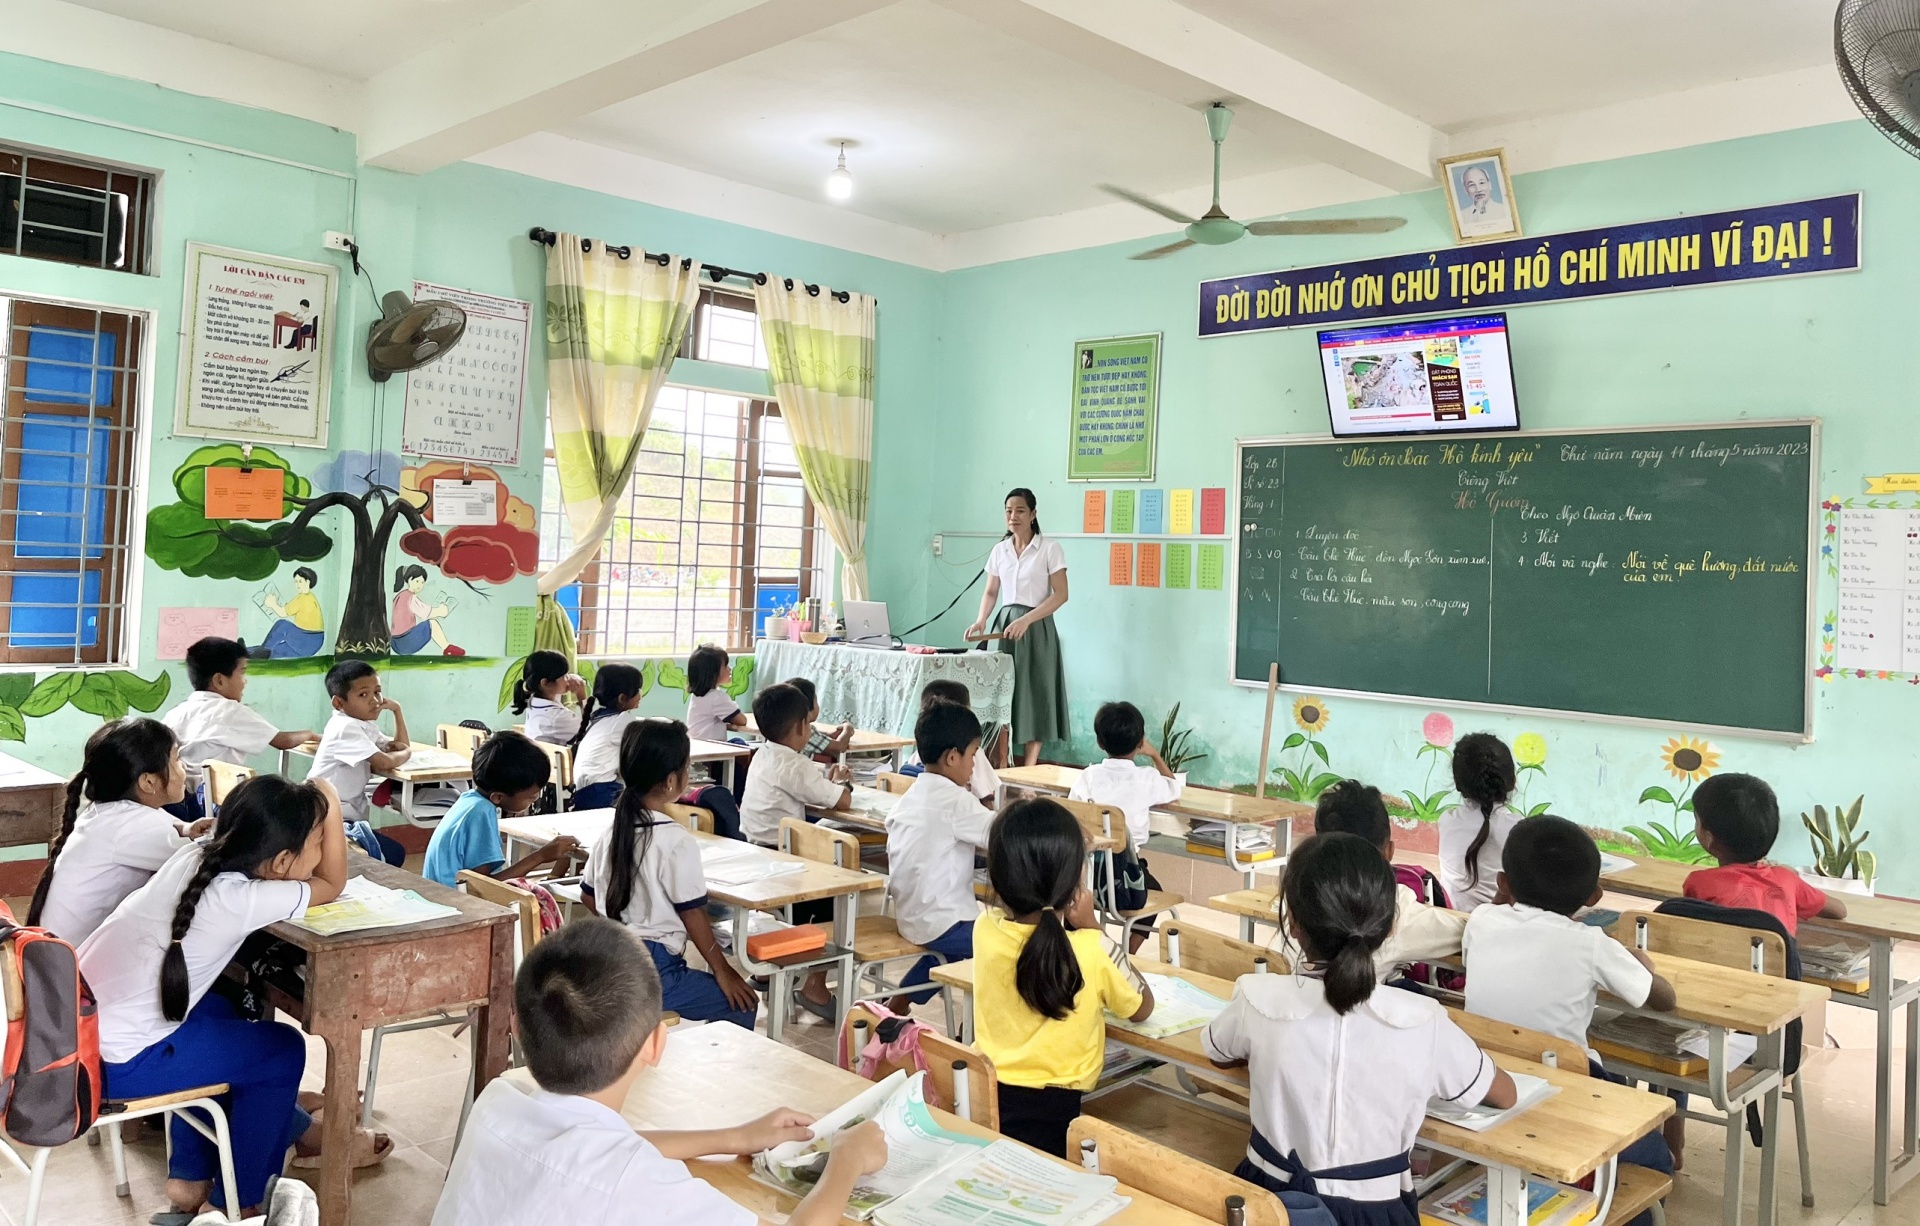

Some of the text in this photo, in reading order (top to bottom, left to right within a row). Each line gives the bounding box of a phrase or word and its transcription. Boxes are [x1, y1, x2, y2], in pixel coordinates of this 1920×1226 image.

[224, 265, 238, 273] LỜI
[277, 273, 293, 283] CÁC
[1216, 289, 1249, 324] ĐỜI
[1256, 285, 1291, 320] ĐỜI
[1298, 276, 1345, 314] NHỚ
[1351, 275, 1384, 310] ƠN
[1391, 253, 1440, 306] CHỦ
[1447, 259, 1507, 306] TỊCH
[1515, 242, 1554, 292] HỒ
[1564, 238, 1607, 285] CHÍ
[1618, 235, 1700, 280] MINH
[1711, 219, 1743, 268] VĨ
[1752, 221, 1810, 266] ĐẠI
[214, 285, 225, 293] Tư
[225, 287, 238, 295] thế
[240, 290, 257, 298] ngồi
[212, 352, 234, 360] Cách
[236, 355, 254, 363] cầm
[1439, 444, 1464, 465] Hồ
[1560, 441, 1809, 468] Thứ năm ngày 11 tháng 5 năm 2023
[1268, 478, 1279, 489] 23
[1520, 506, 1549, 520] Theo
[1535, 528, 1559, 544] Viết
[1534, 551, 1556, 567] Nói
[1562, 555, 1575, 568] và
[1621, 551, 1647, 570] Nói
[1652, 554, 1669, 570] về
[1674, 559, 1697, 577] quê
[1742, 556, 1766, 572] đất
[1770, 556, 1799, 573] nước
[1341, 574, 1357, 583] câu
[1623, 570, 1647, 583] của
